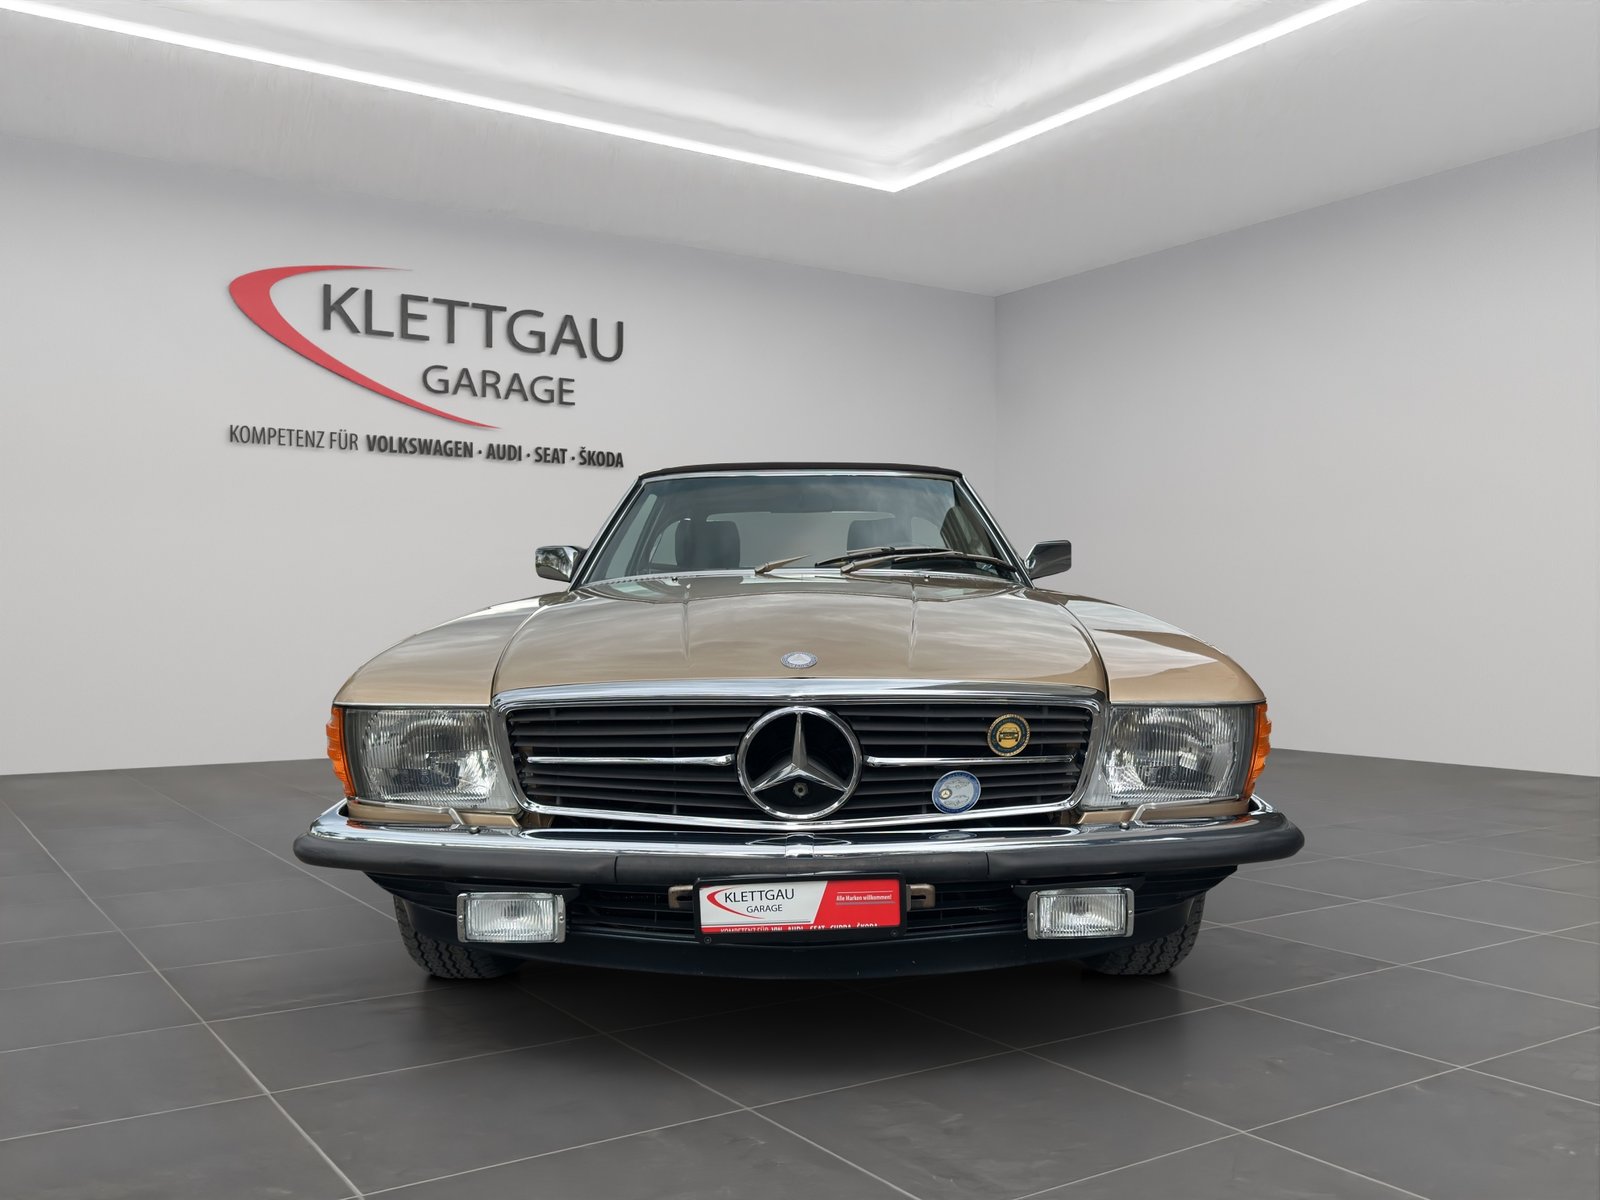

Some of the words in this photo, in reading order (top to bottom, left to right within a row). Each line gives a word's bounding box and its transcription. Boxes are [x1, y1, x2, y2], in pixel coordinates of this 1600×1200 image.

[322, 283, 625, 362] KLETTGAU
[421, 365, 576, 406] GARAGE
[229, 424, 325, 450] KOMPETENZ
[329, 429, 359, 452] FÜR
[366, 434, 474, 459] VOLKSWAGEN
[485, 443, 523, 462] AUDI
[534, 446, 568, 465] SEAT
[579, 446, 625, 469] ŠKODA
[724, 888, 795, 903] KLETTGAU
[746, 904, 783, 913] GARAGE
